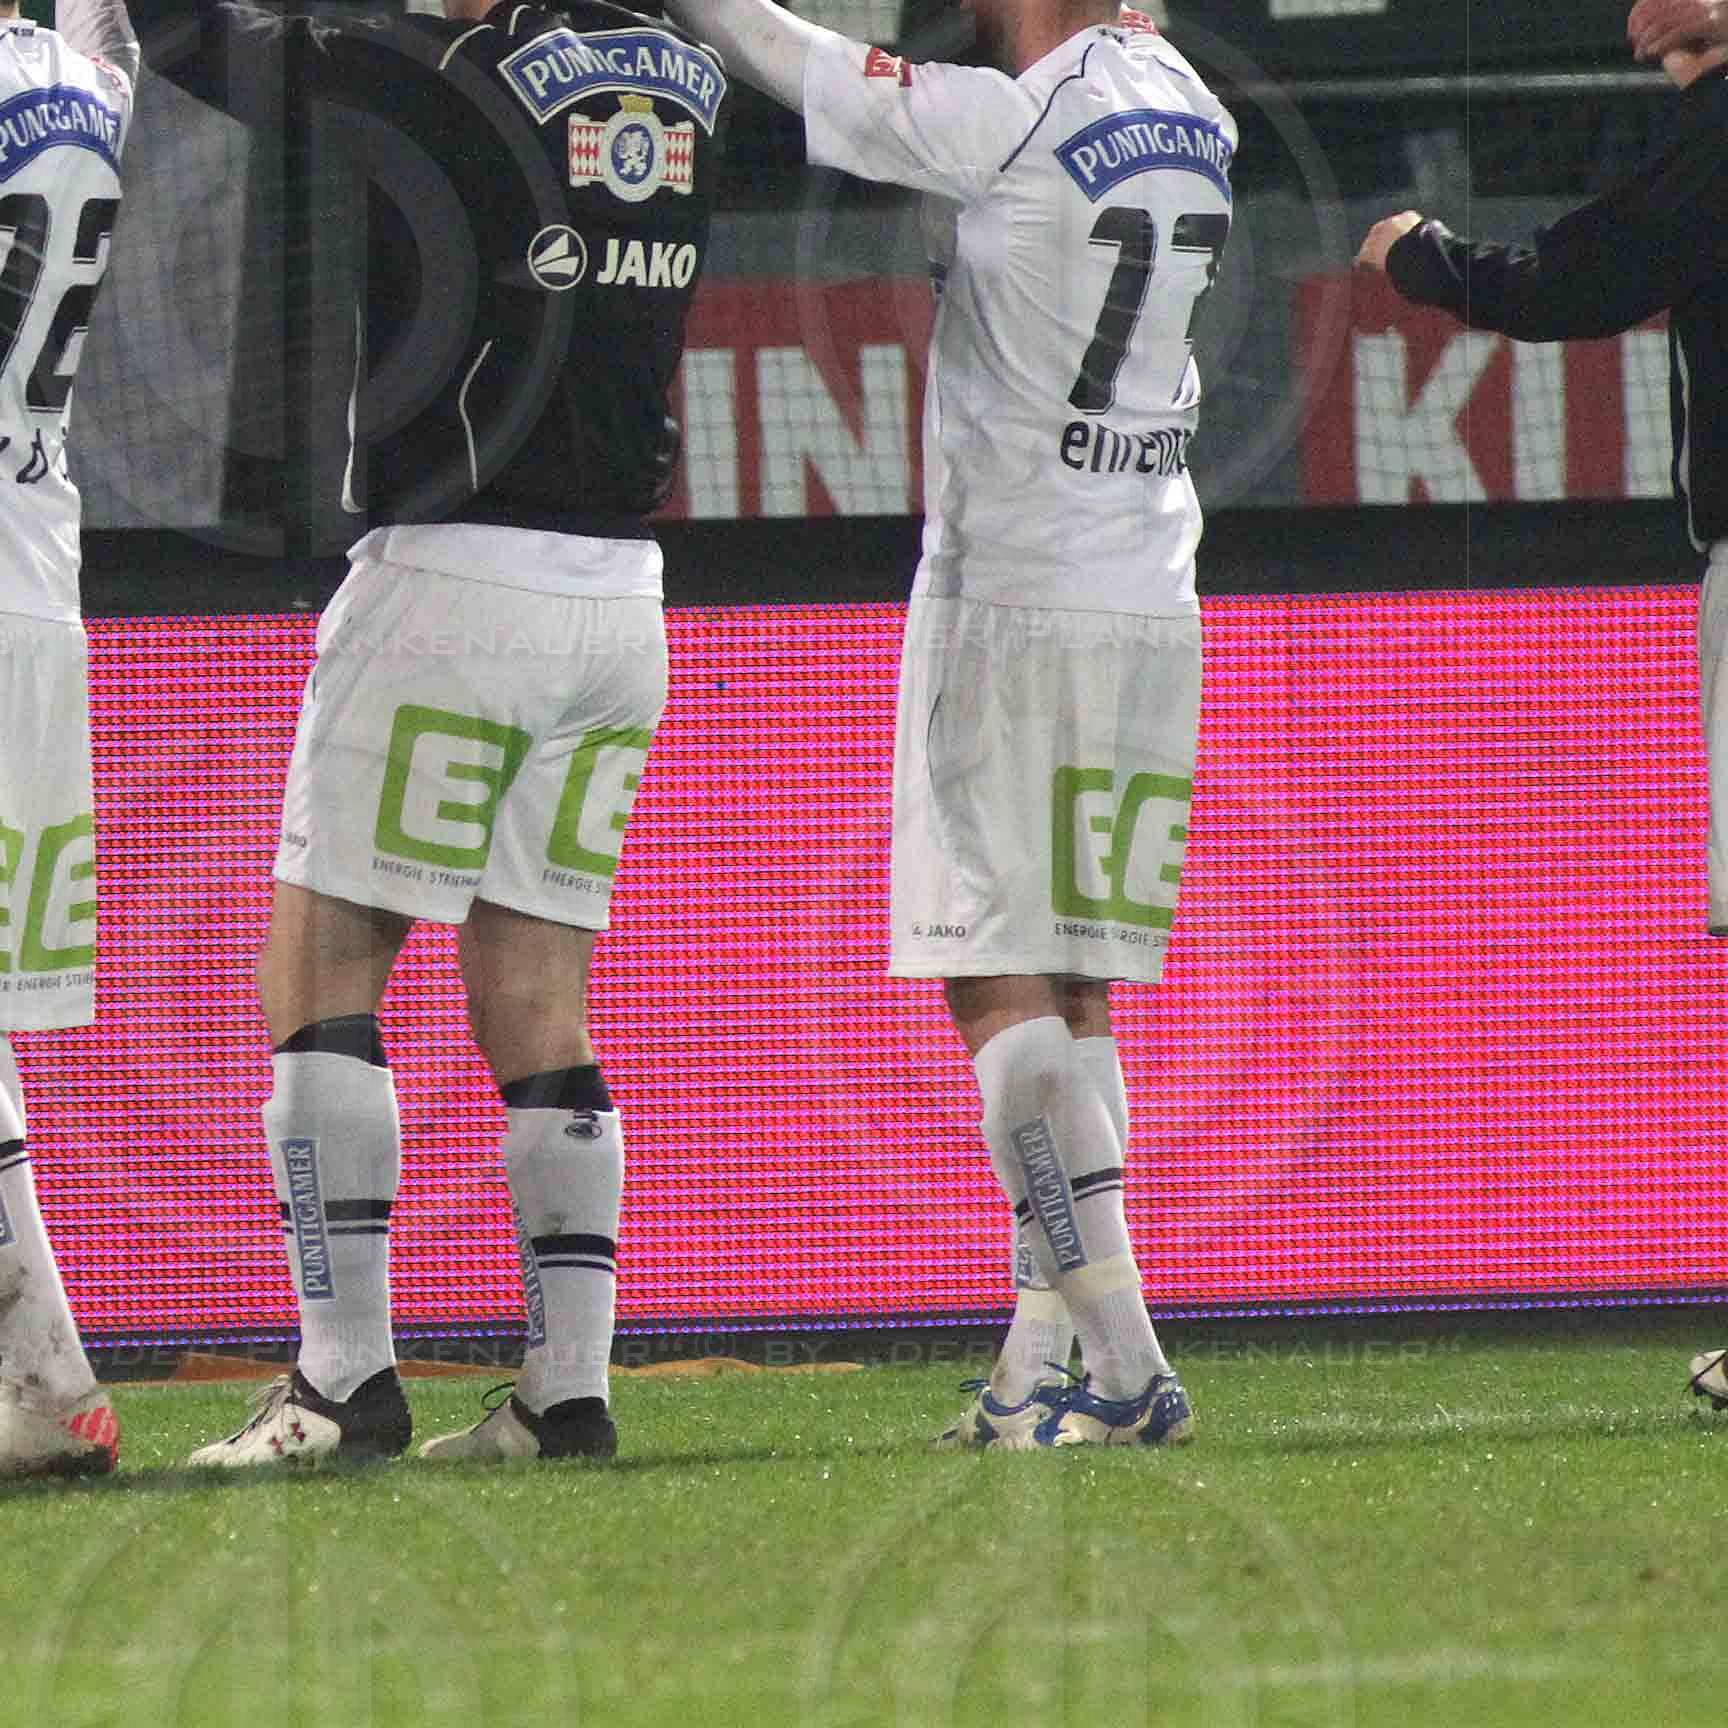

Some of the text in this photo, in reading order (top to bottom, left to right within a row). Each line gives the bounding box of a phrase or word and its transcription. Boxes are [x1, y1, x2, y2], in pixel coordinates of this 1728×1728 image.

[1071, 121, 1230, 184] PUNTIGAME
[595, 238, 697, 289] JAKO
[927, 923, 966, 940] JAKO
[287, 1143, 329, 1292] PUNTIGAMER
